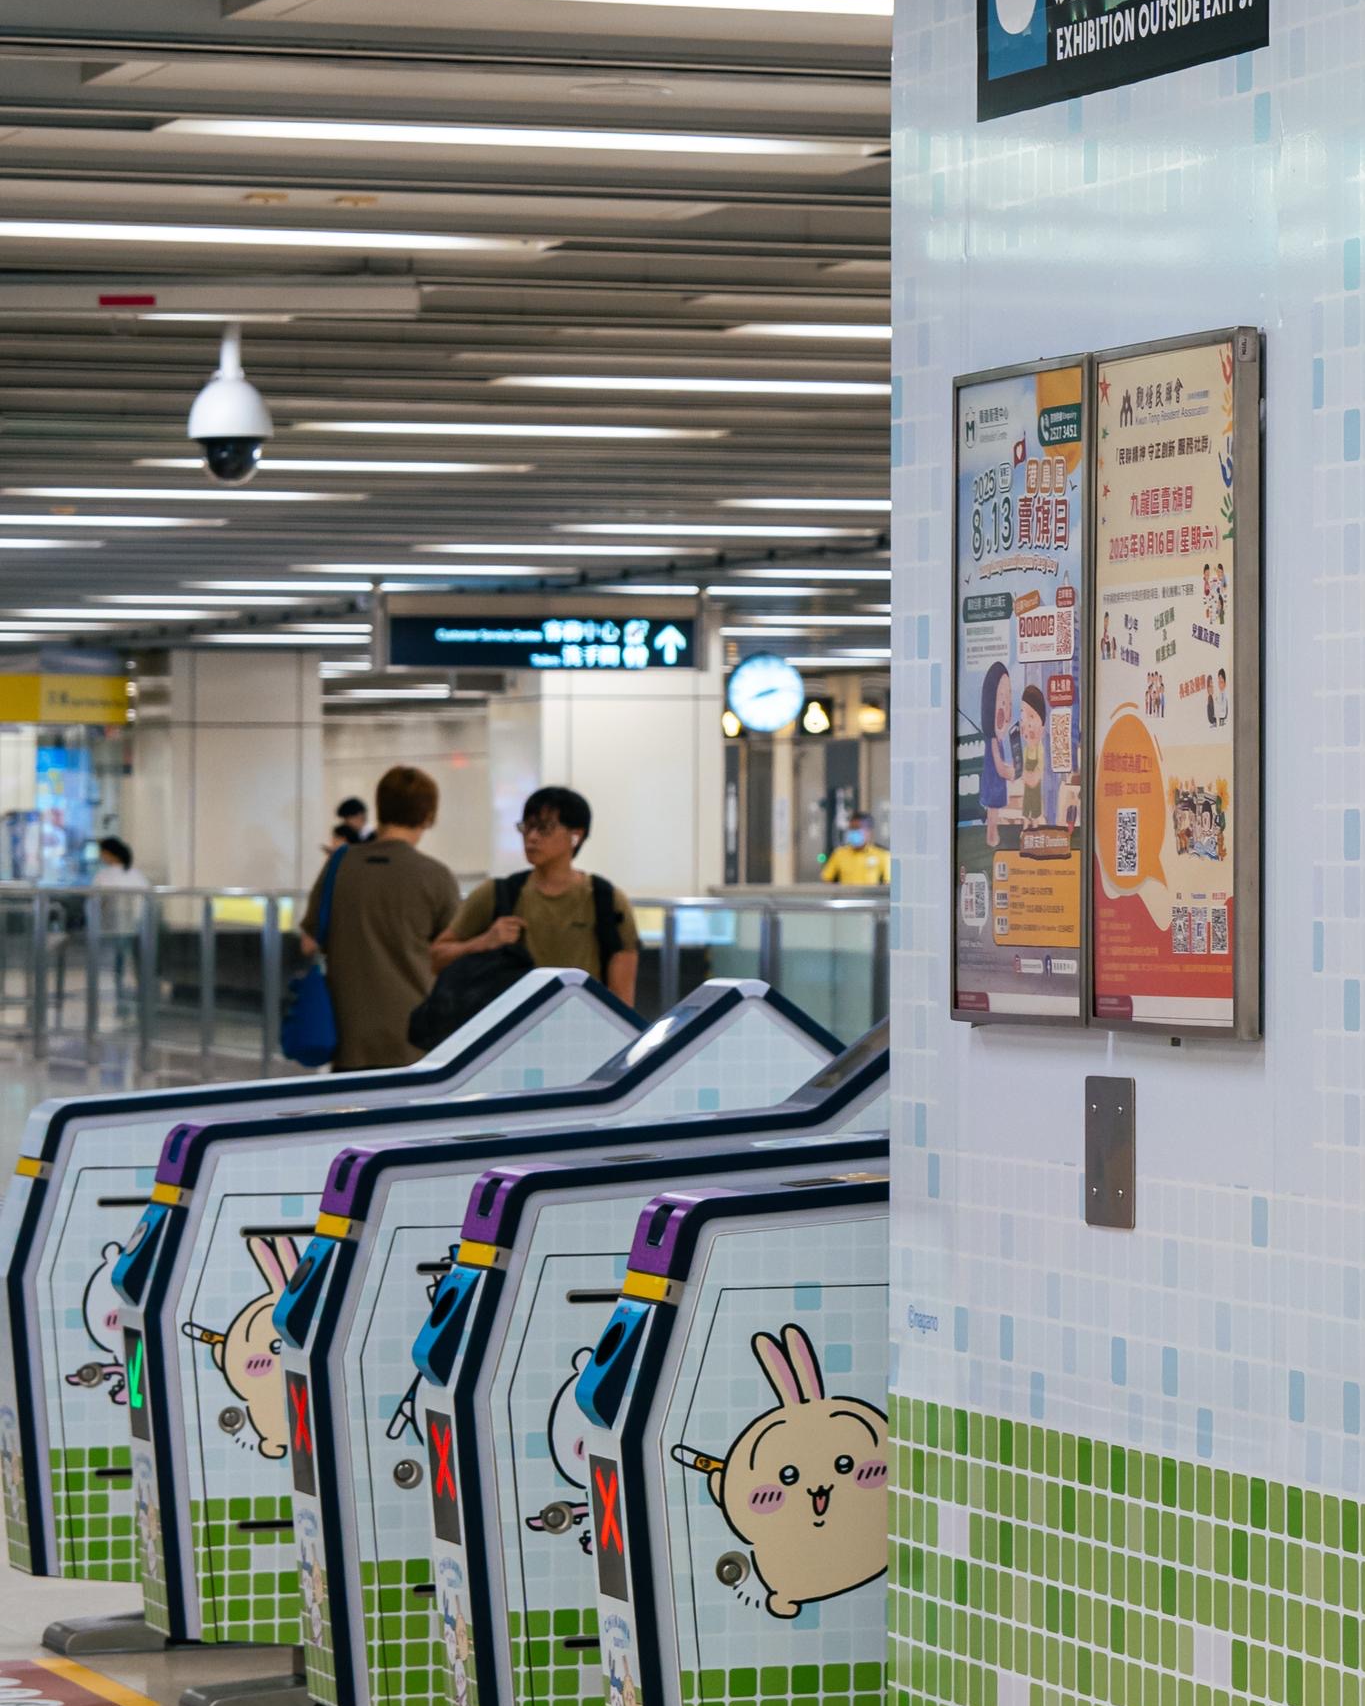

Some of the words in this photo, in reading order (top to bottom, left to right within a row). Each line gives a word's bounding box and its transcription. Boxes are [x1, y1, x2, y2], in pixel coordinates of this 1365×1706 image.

[1056, 12, 1136, 61] EXHIBITION
[972, 496, 1012, 556] 8.13
[1018, 496, 1070, 547] 賣旗日
